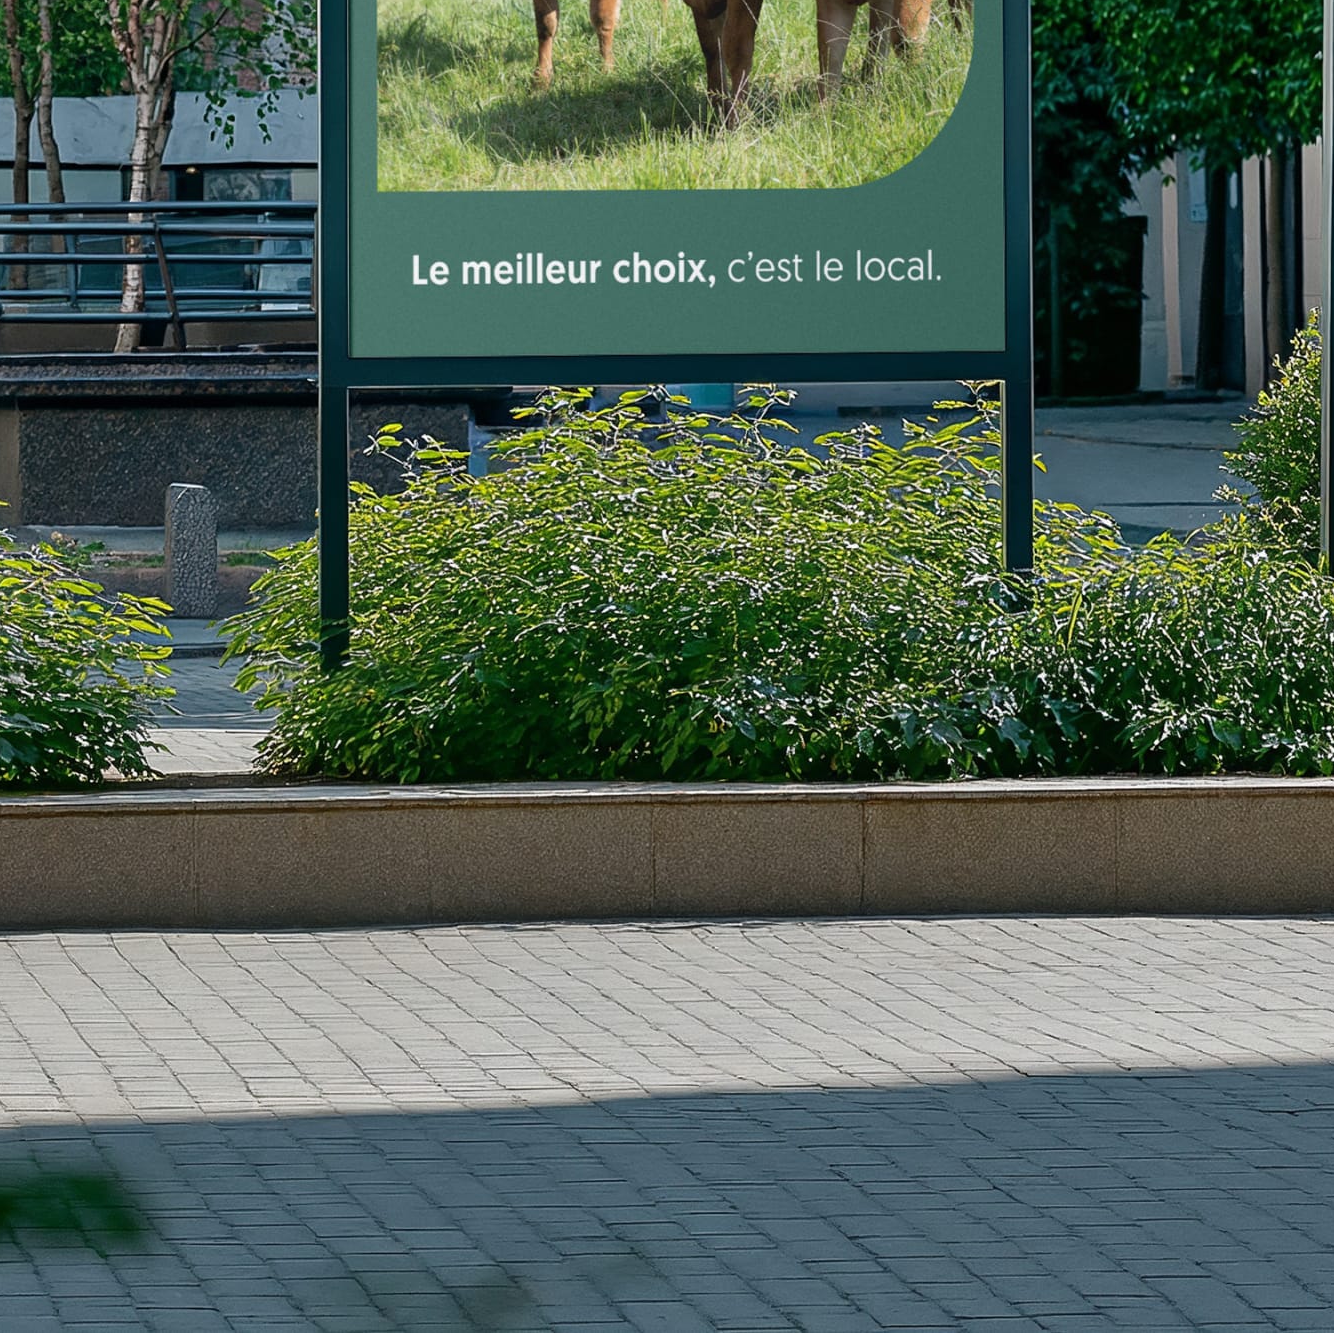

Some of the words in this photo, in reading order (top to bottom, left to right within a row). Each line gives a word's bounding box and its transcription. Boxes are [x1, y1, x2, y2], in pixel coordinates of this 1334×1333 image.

[412, 254, 450, 286] Le
[462, 252, 602, 285] meilleur
[612, 251, 716, 288] choix,
[815, 249, 844, 282] le
[856, 249, 942, 282] local.
